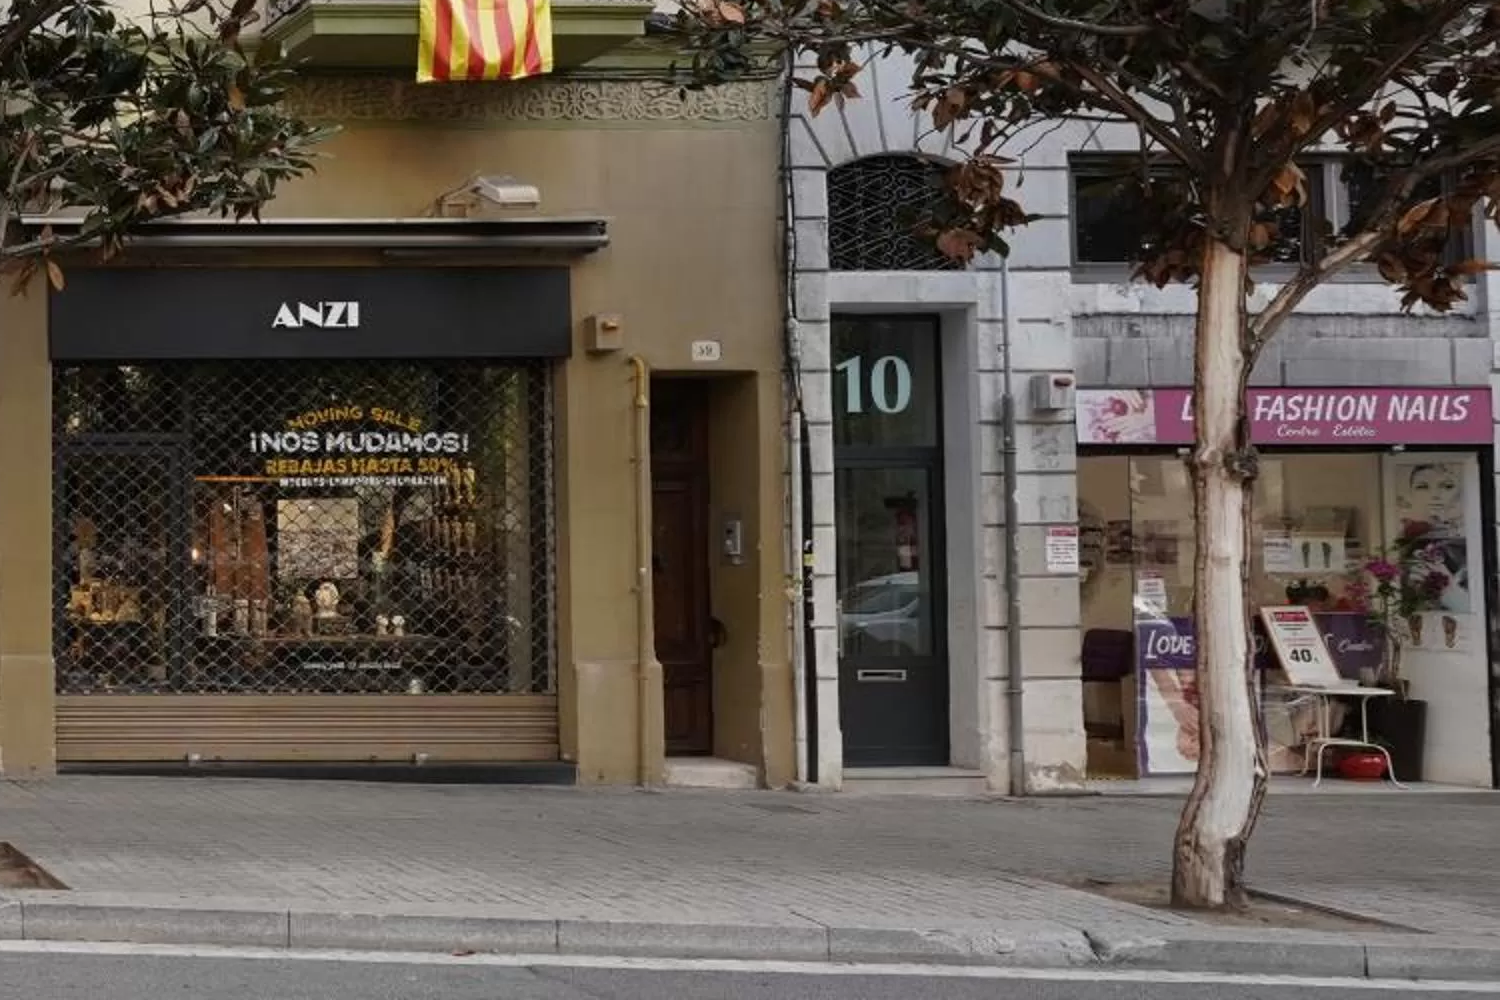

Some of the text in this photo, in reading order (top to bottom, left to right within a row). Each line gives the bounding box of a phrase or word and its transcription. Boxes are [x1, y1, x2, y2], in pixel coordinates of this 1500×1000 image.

[271, 301, 359, 328] ANZI
[836, 355, 911, 413] 10
[1254, 394, 1471, 421] FASHION NAILS
